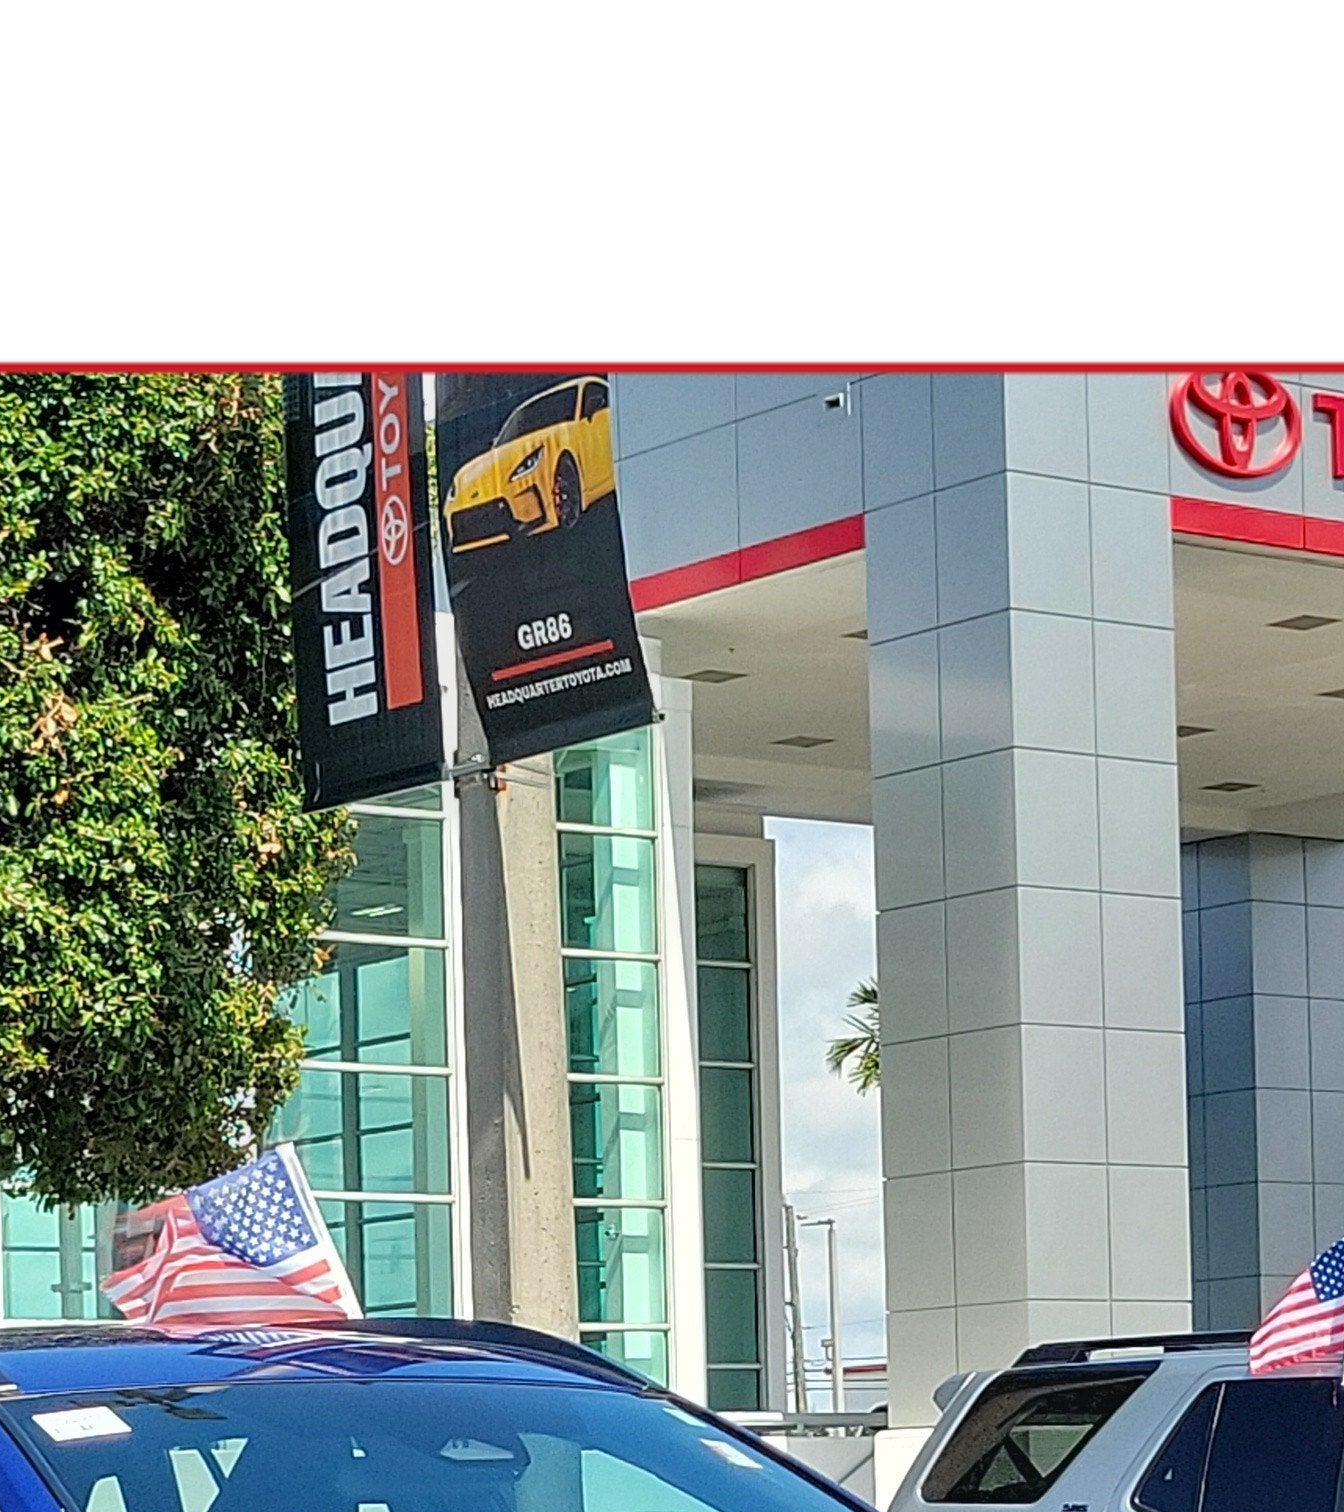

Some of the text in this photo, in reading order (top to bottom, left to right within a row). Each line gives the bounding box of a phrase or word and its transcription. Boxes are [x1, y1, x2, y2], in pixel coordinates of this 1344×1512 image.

[377, 372, 402, 492] TOY
[313, 372, 378, 727] HEADQU
[517, 612, 573, 651] GR86
[486, 657, 633, 710] HEADQUARTERTOYOTA.COM
